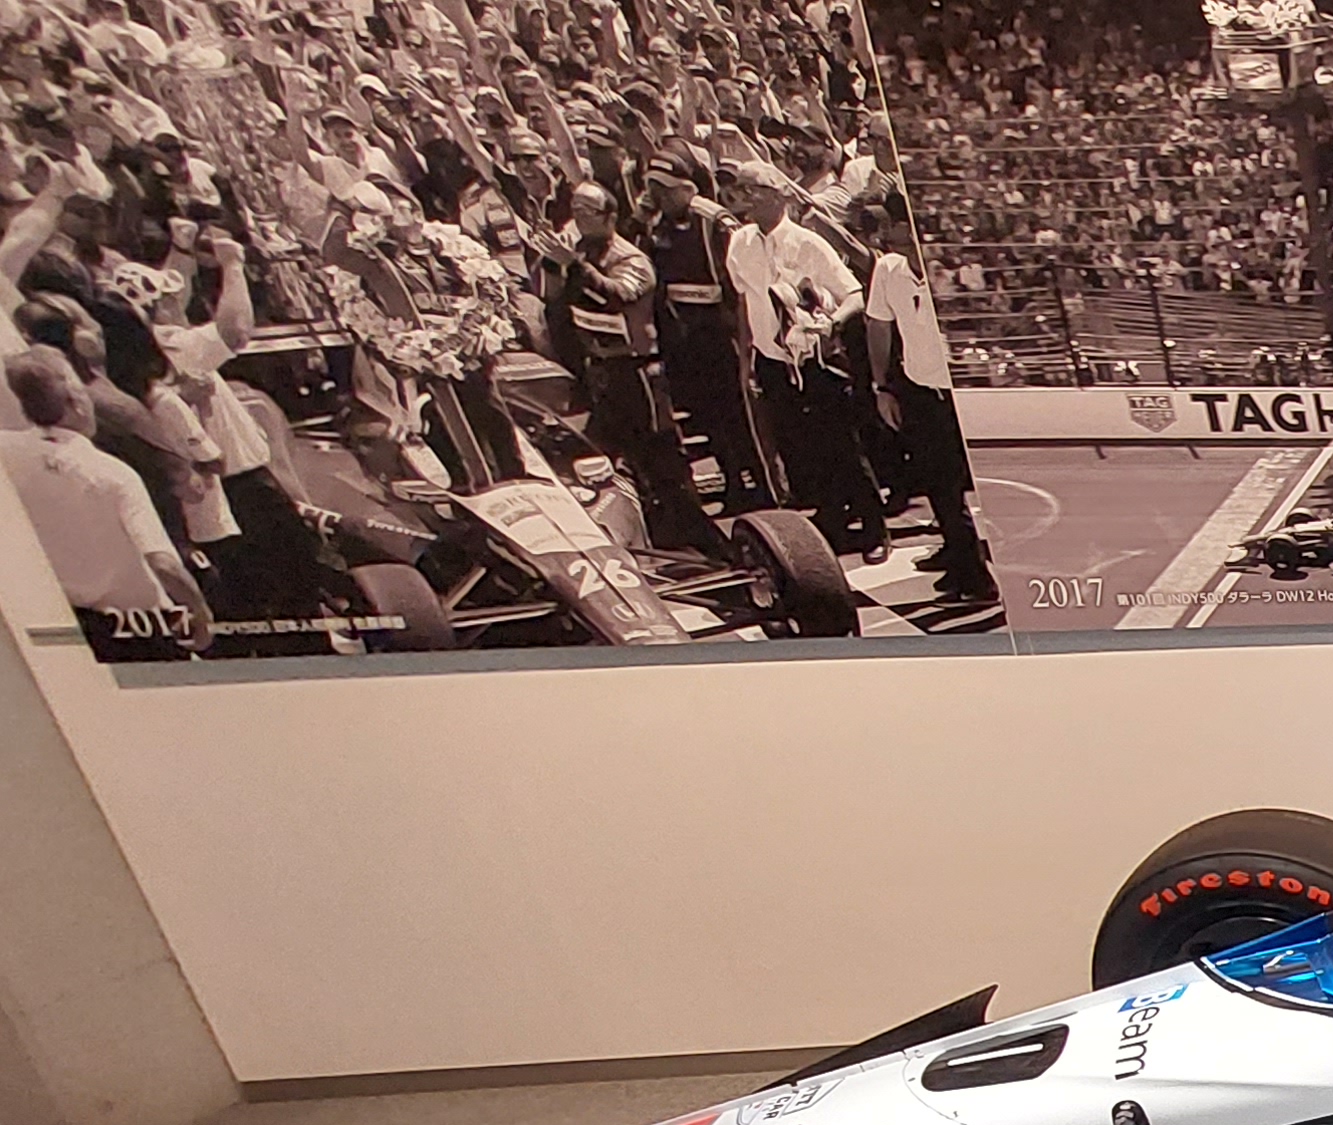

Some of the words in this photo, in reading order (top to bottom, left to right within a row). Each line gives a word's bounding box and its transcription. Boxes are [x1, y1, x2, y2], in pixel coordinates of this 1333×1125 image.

[567, 558, 641, 600] 26
[1028, 578, 1104, 609] 2017
[1276, 590, 1315, 602] DW12
[103, 605, 194, 638] 2017
